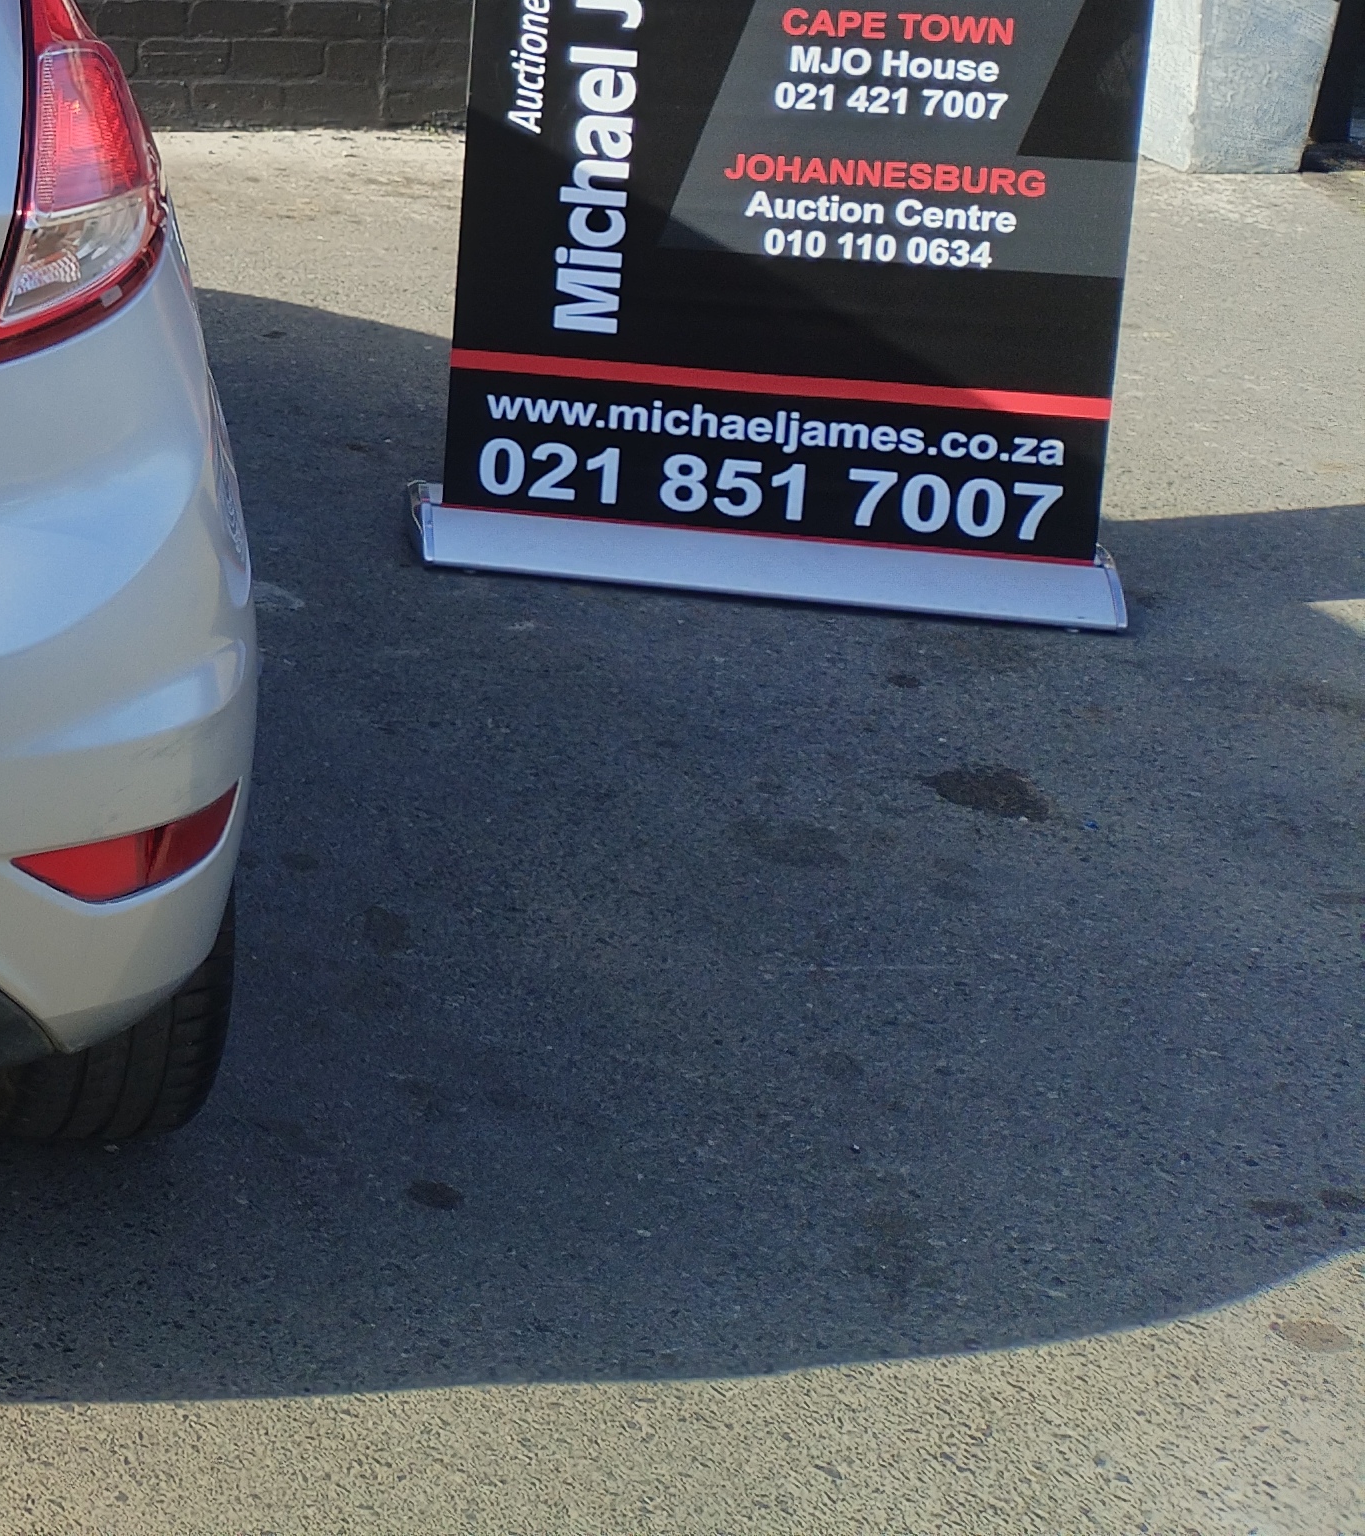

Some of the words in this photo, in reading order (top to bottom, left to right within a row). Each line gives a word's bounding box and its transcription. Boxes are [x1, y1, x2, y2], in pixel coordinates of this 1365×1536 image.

[782, 7, 887, 39] CAPE
[898, 13, 1014, 46] TOWN
[789, 45, 872, 76] MJO
[881, 49, 1000, 83] House
[774, 81, 835, 112] 021
[846, 85, 908, 115] 421
[921, 88, 1009, 120] 7007
[553, 45, 638, 334] Michael
[724, 153, 1046, 198] JOHANNESBURG
[744, 190, 885, 225] Auction
[895, 198, 1017, 234] Centre
[763, 227, 827, 258] 010
[837, 231, 897, 262] 110
[906, 236, 993, 269] 0634
[485, 395, 1066, 466] www.michaeljames.co.za
[479, 437, 620, 505] 021
[659, 453, 806, 521] 851
[848, 468, 1064, 541] 7007
